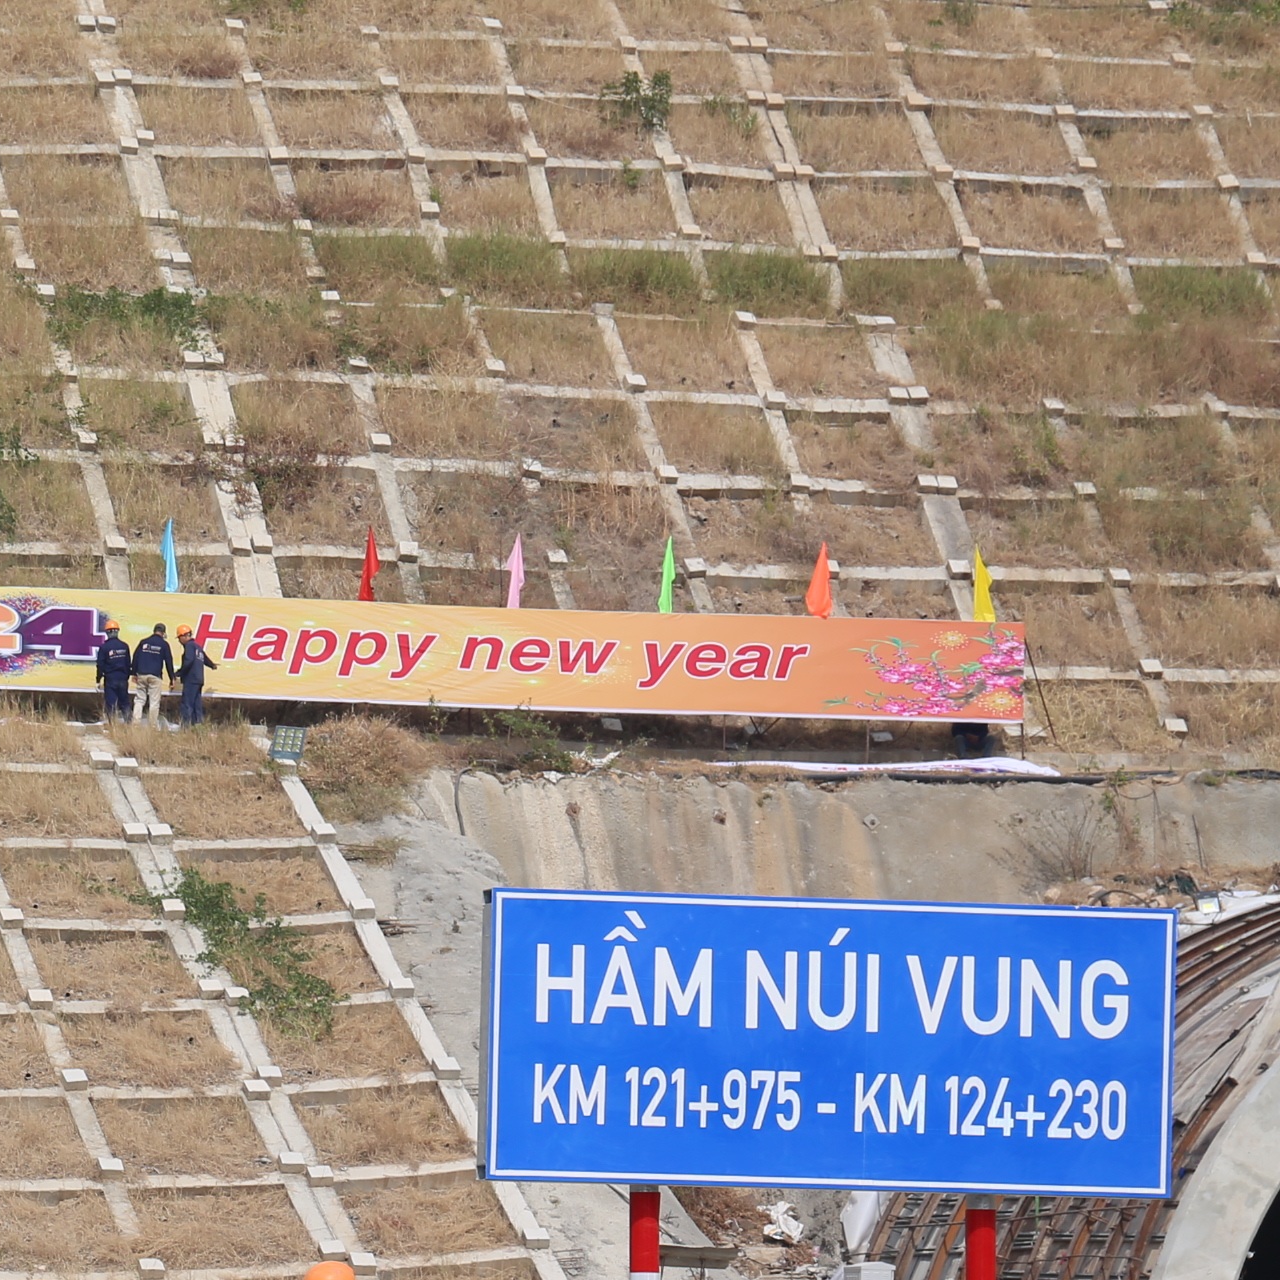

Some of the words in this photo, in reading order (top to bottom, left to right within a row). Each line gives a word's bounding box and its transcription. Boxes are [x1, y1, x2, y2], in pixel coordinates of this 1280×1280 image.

[193, 612, 437, 680] Happy
[459, 635, 617, 675] new
[639, 641, 809, 690] year
[535, 910, 713, 1028] HẦM
[745, 927, 880, 1033] NÚI
[906, 955, 1129, 1040] VUNG
[533, 1063, 606, 1125] KM
[625, 1066, 801, 1131] 121+975
[854, 1072, 927, 1134] KM
[945, 1075, 1127, 1141] 124+230
